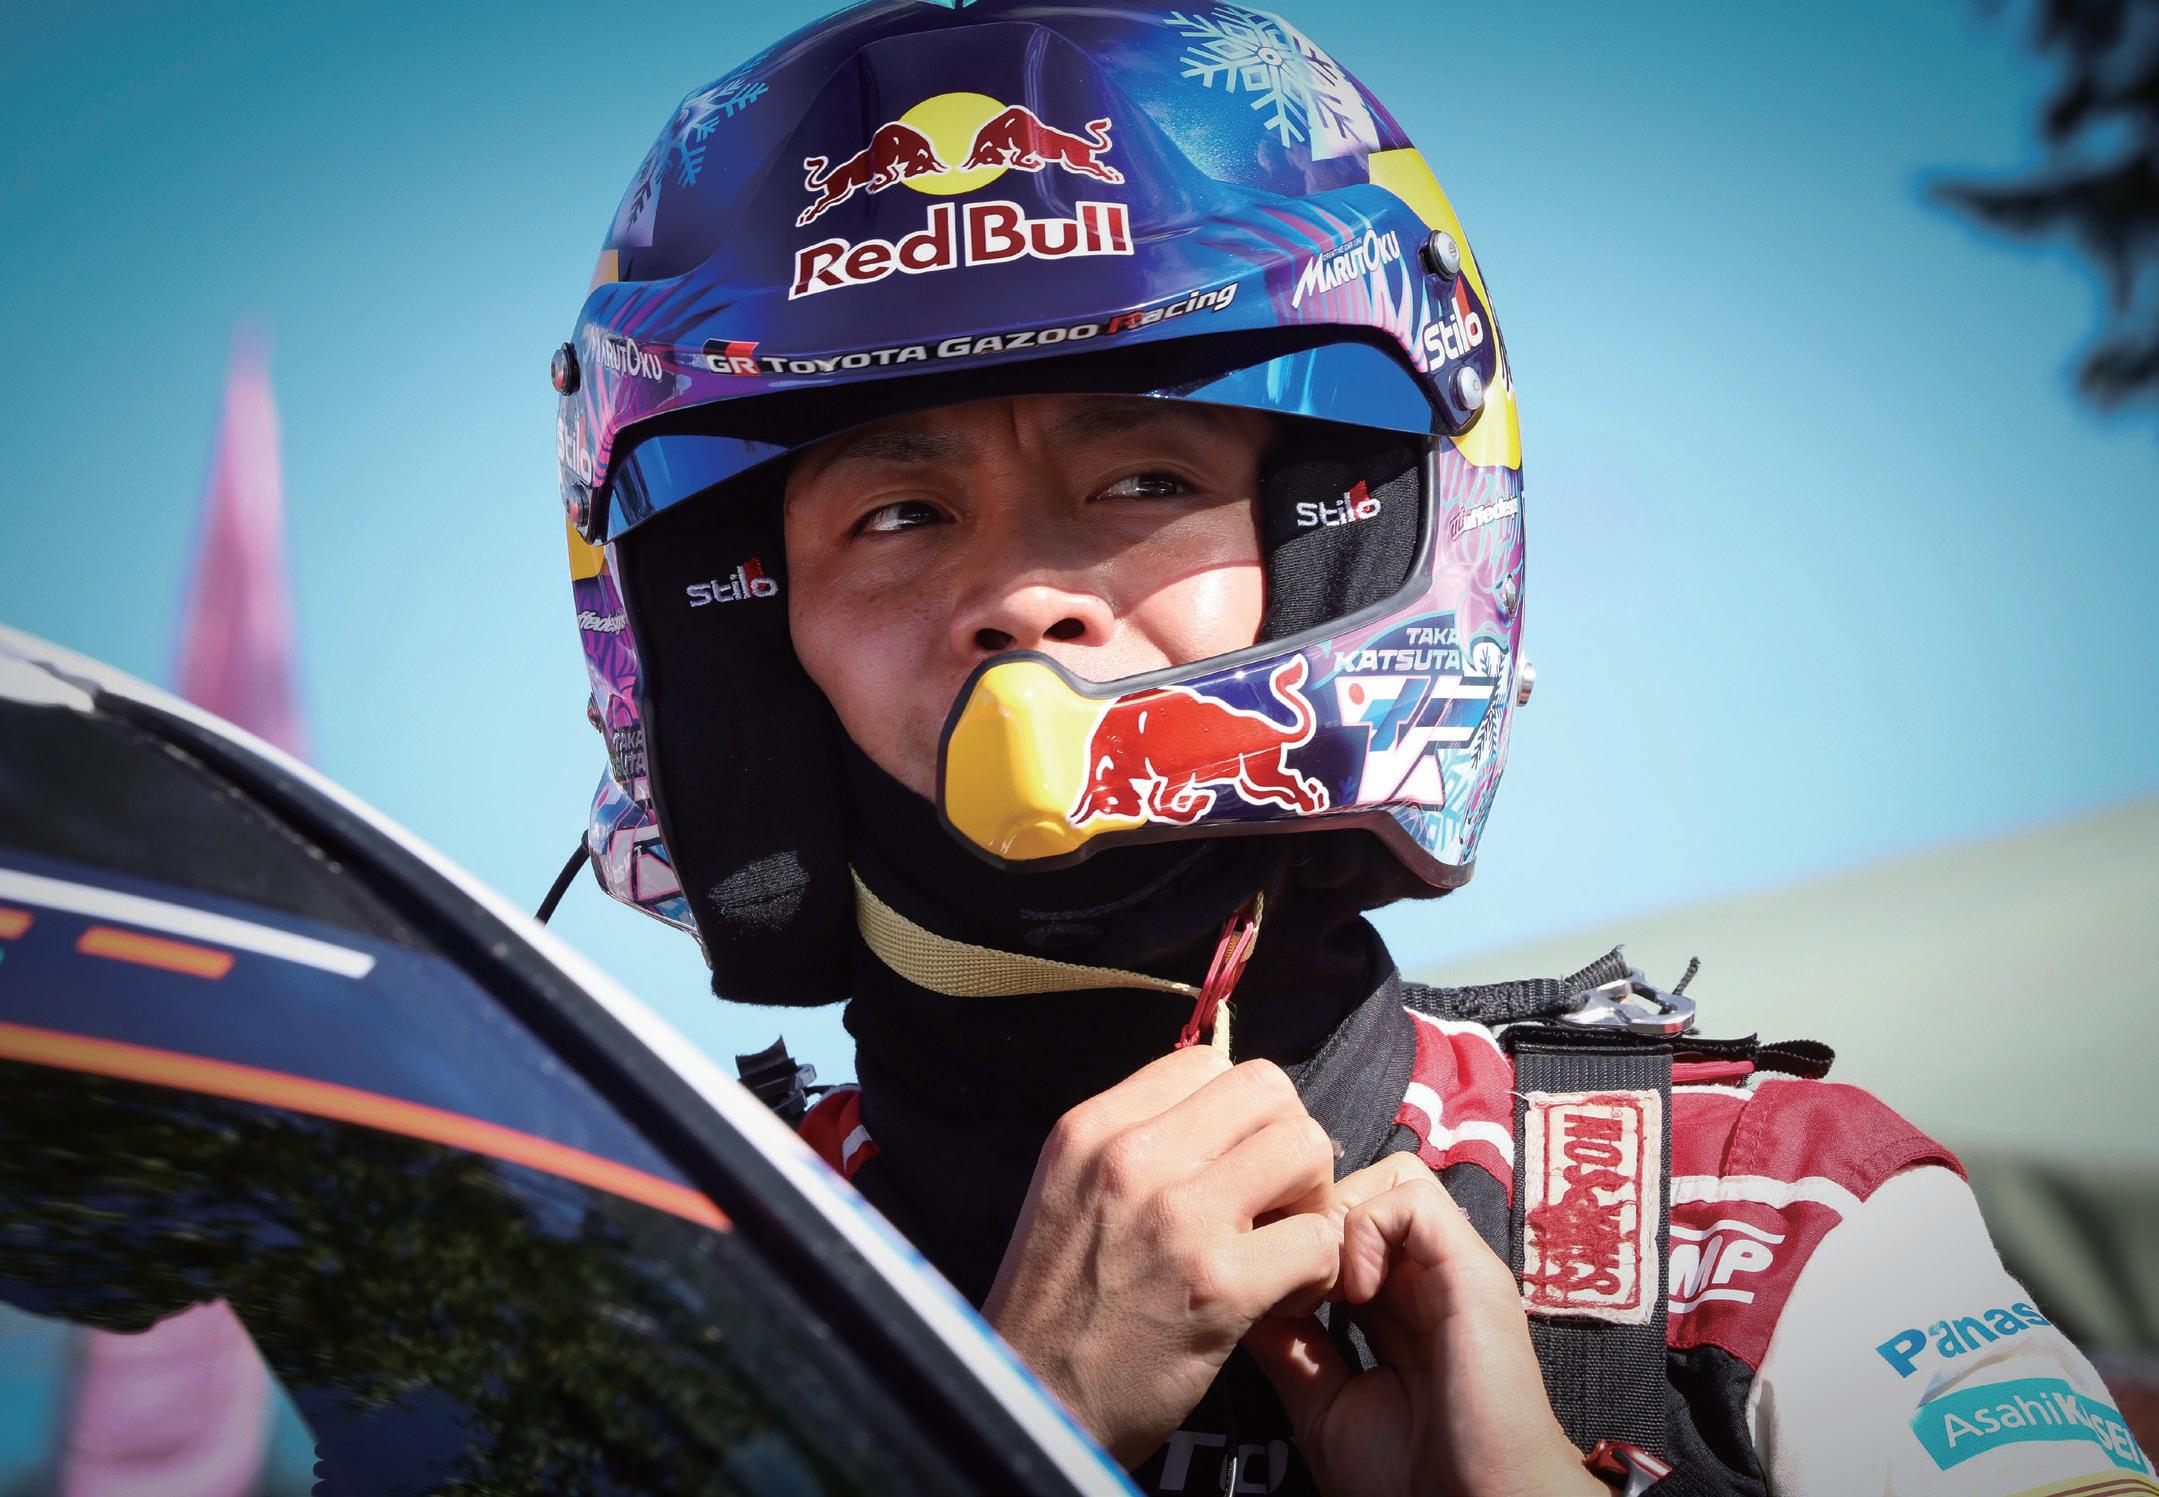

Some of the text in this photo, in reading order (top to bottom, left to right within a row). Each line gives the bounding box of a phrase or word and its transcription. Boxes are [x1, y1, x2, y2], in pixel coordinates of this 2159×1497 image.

[788, 199, 1134, 301] Red Bull
[705, 281, 1240, 377] GR TOYOTA GAZOO Racing
[1295, 483, 1382, 527] Stilo
[685, 561, 779, 607] Stilo
[1405, 627, 1459, 645] TAKA
[1333, 649, 1462, 673] KATSUTA
[1942, 1391, 2142, 1466] AsahiKSEI
